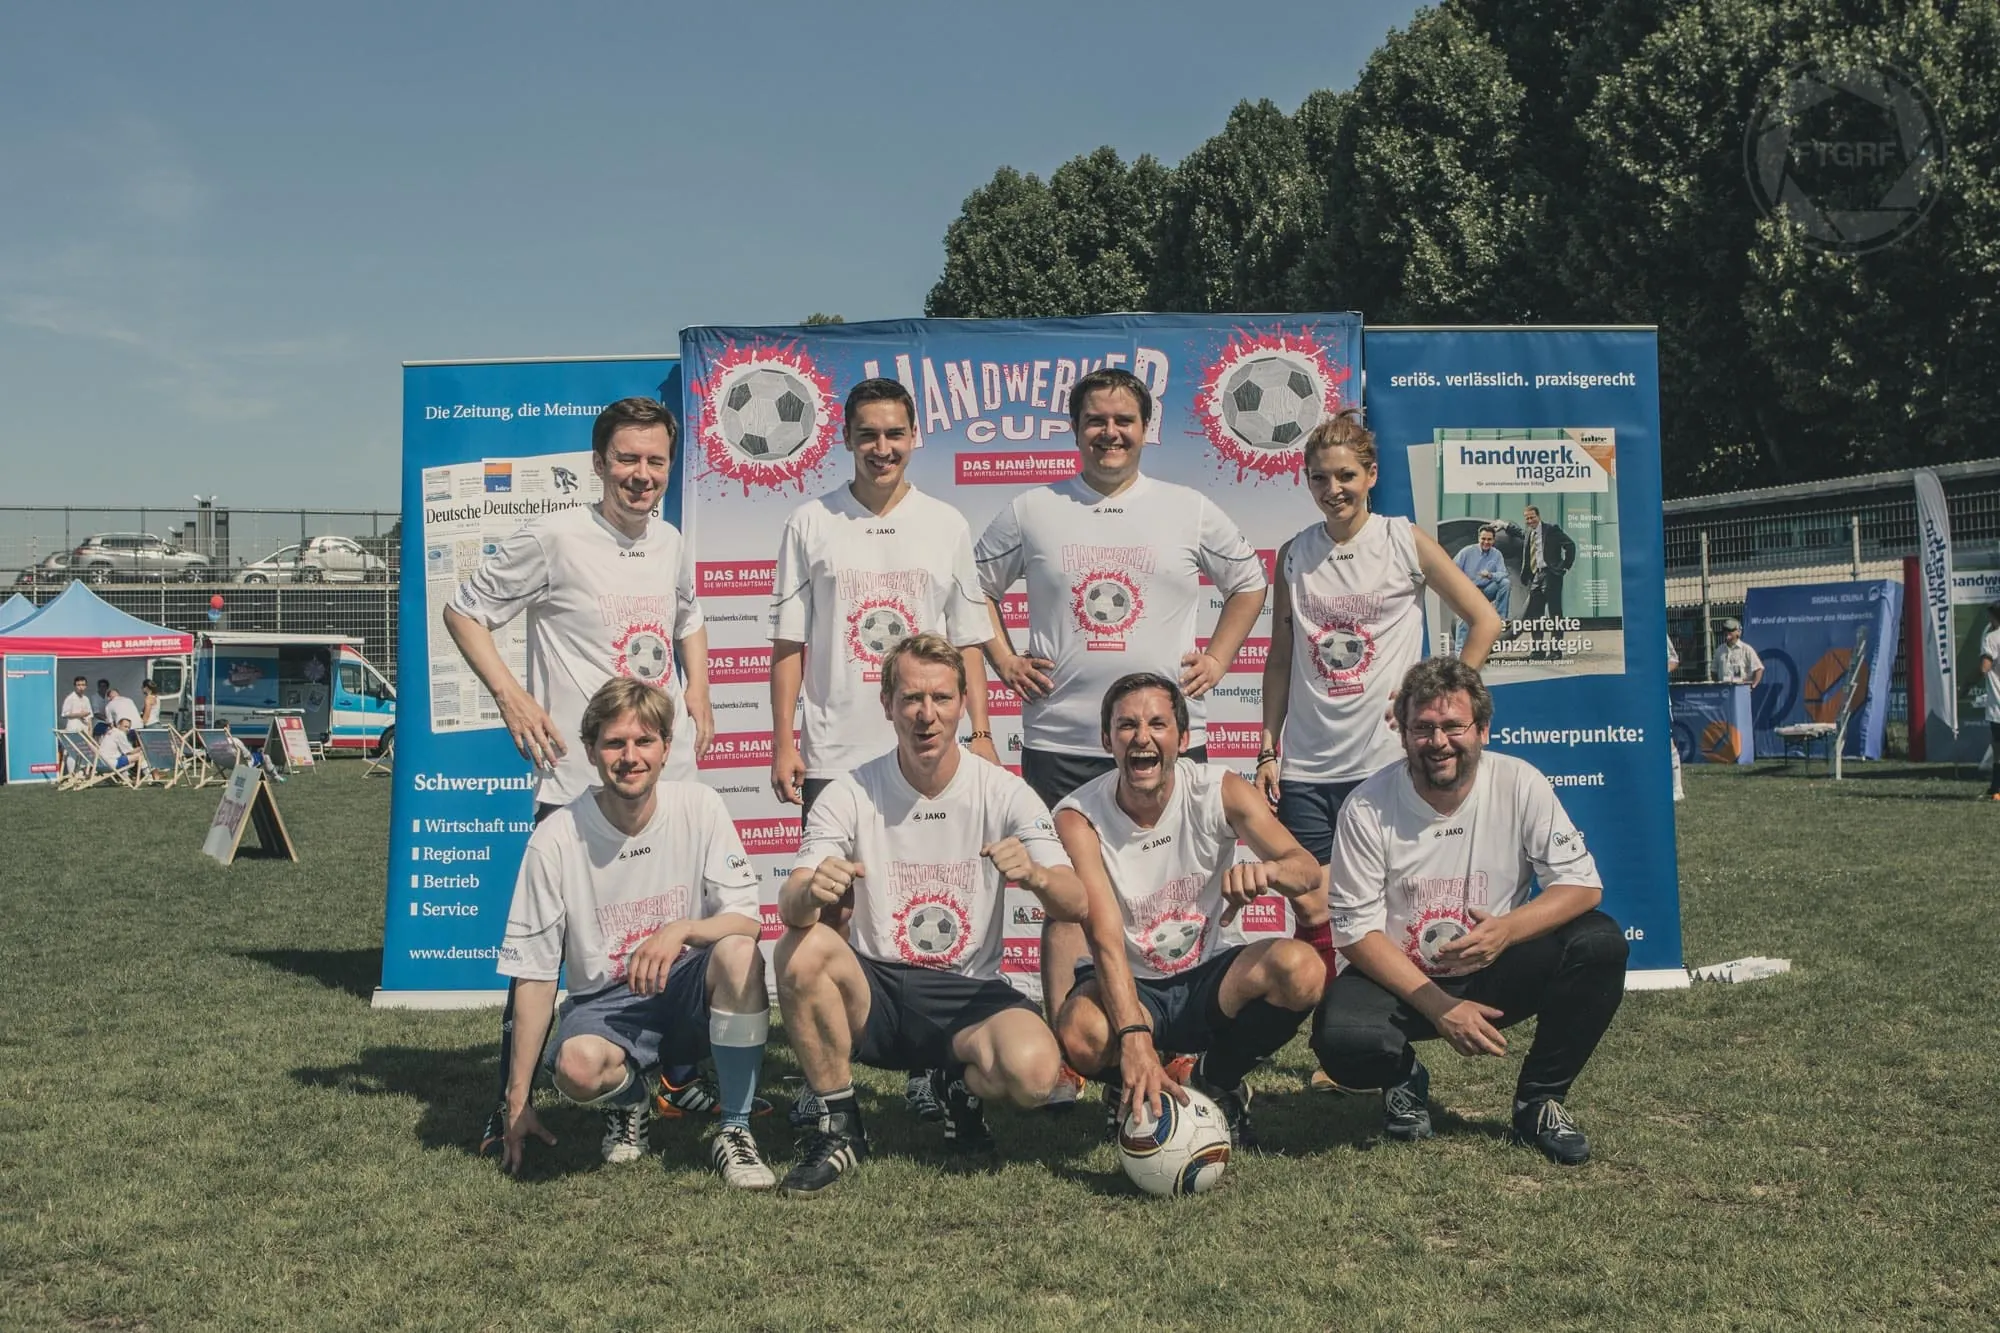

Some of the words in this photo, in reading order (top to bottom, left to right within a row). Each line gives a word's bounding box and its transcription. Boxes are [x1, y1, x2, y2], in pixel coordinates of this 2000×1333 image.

[1390, 372, 1440, 387] seriös.
[1445, 372, 1529, 387] verlässlich.
[1535, 371, 1635, 389] praxisgerecht
[864, 347, 1169, 449] HANDWERR
[425, 406, 450, 420] Die
[453, 403, 514, 420] Zeitung,
[518, 403, 541, 417] die
[966, 415, 1072, 444] CUP
[963, 460, 991, 471] DAS
[995, 455, 1076, 470] HANDWERK
[1460, 446, 1574, 465] handwerk
[1516, 461, 1591, 483] magazin
[425, 503, 481, 525] Deutsche
[483, 497, 540, 515] Deutsche
[1336, 553, 1354, 561] JAKO
[703, 569, 734, 581] DAS
[1512, 615, 1580, 635] perfekte
[101, 640, 122, 649] DAS
[923, 811, 946, 820] JAKO
[425, 818, 505, 833] Wirtschaft
[741, 821, 802, 839] HANDW
[1445, 828, 1464, 837] JAKO
[1152, 835, 1172, 848] JAKO
[423, 846, 491, 864] Regional
[629, 847, 651, 858] JAKO
[423, 873, 480, 889] Betrieb
[422, 902, 479, 917] Service
